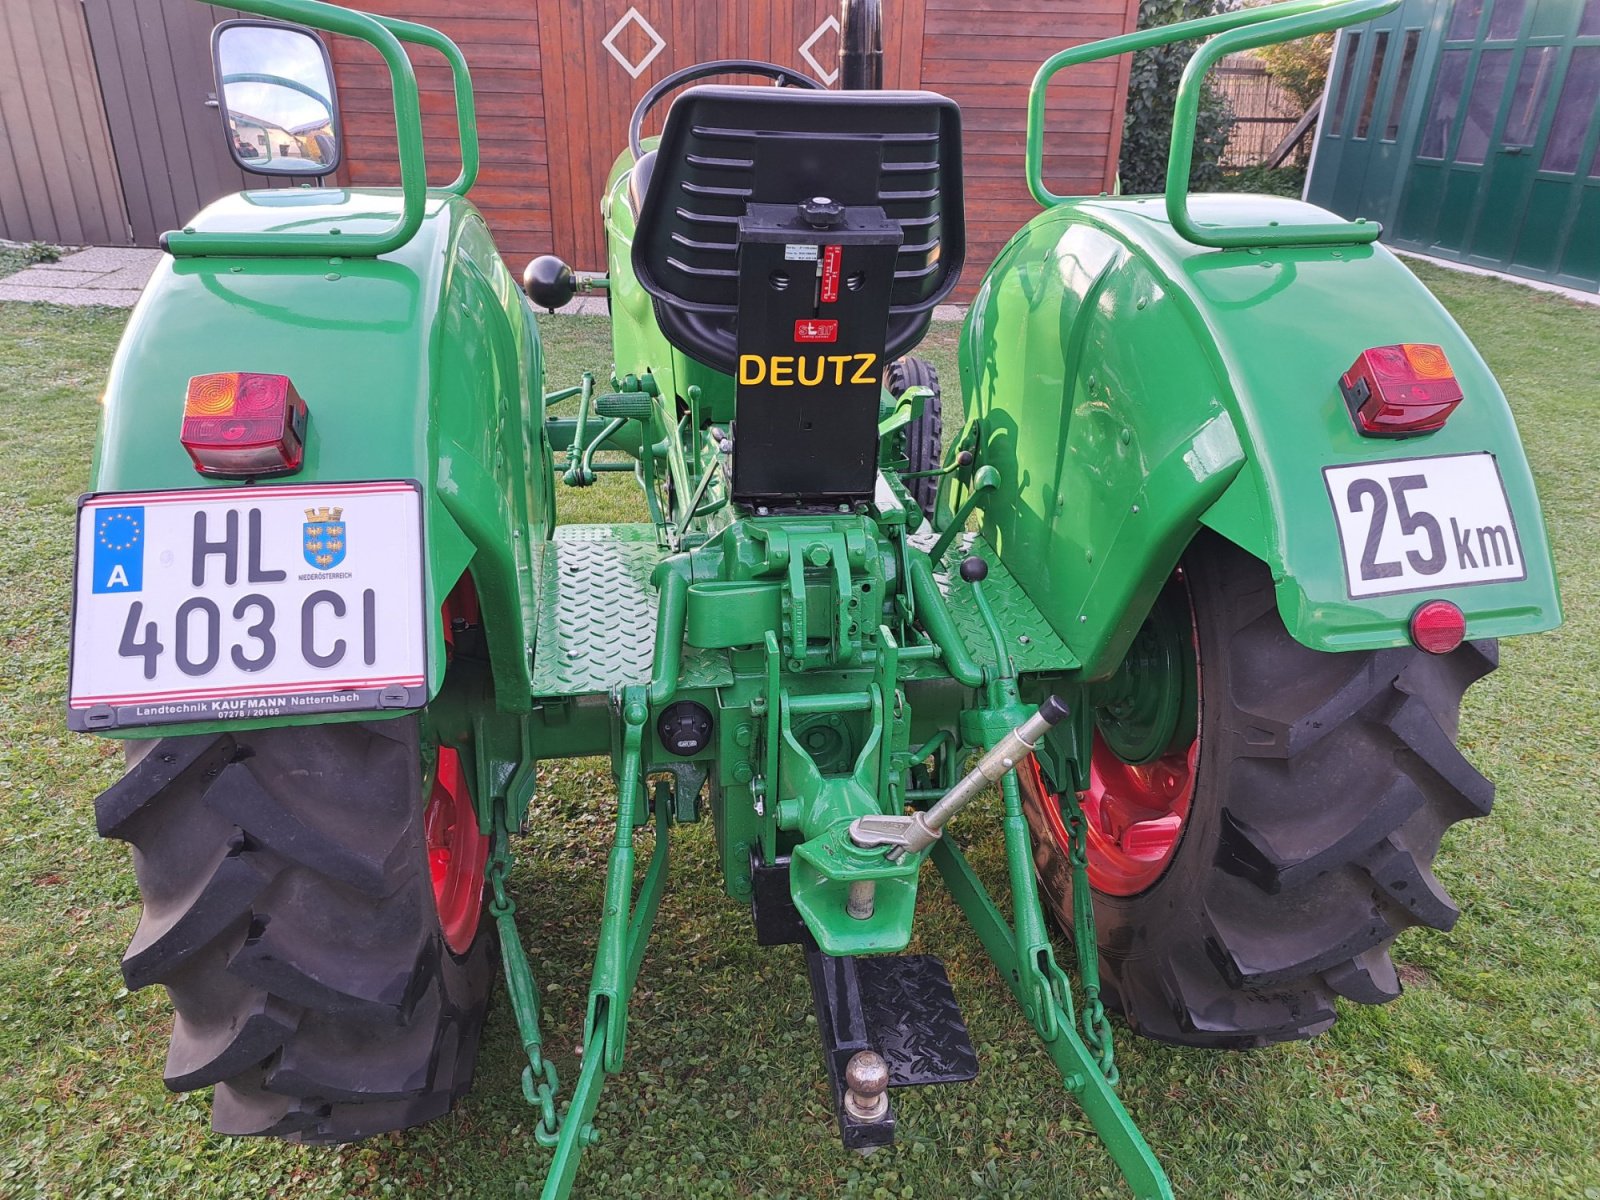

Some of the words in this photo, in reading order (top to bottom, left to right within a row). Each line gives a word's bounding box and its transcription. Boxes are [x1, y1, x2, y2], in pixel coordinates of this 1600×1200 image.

[798, 322, 834, 335] star
[740, 354, 876, 385] DEUTZ
[1347, 475, 1447, 581] 25
[1450, 517, 1513, 570] km
[191, 507, 287, 587] HL
[107, 564, 129, 588] A
[298, 571, 353, 582] NIEDERÖSTERREICH
[118, 593, 276, 680] 403
[301, 588, 376, 668] CI
[136, 701, 208, 717] Landtechnik
[211, 697, 287, 711] KAUFMANN
[290, 692, 360, 706] Natternbach
[217, 709, 245, 719] 07278
[252, 707, 280, 717] 20165
